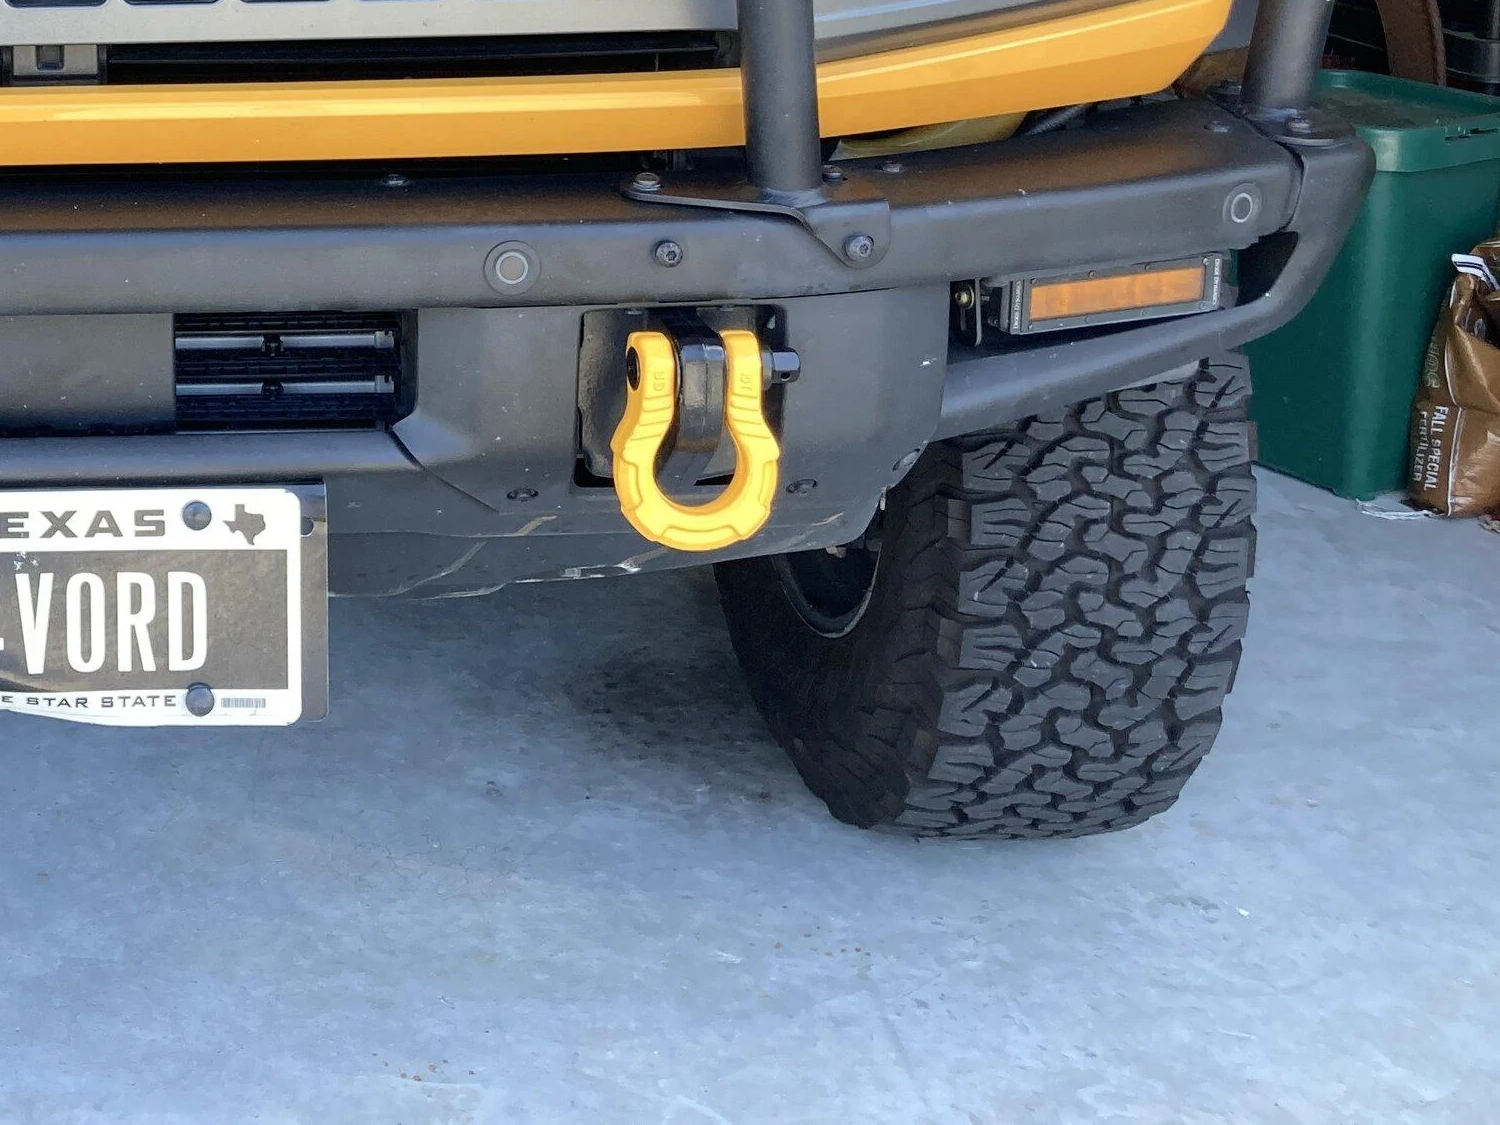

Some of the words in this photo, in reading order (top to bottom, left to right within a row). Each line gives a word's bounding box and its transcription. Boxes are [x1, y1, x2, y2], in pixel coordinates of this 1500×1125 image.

[1430, 405, 1449, 435] FALL
[1424, 438, 1442, 491] SPECIAL
[26, 696, 89, 709] STAR
[101, 695, 177, 708] STATE
